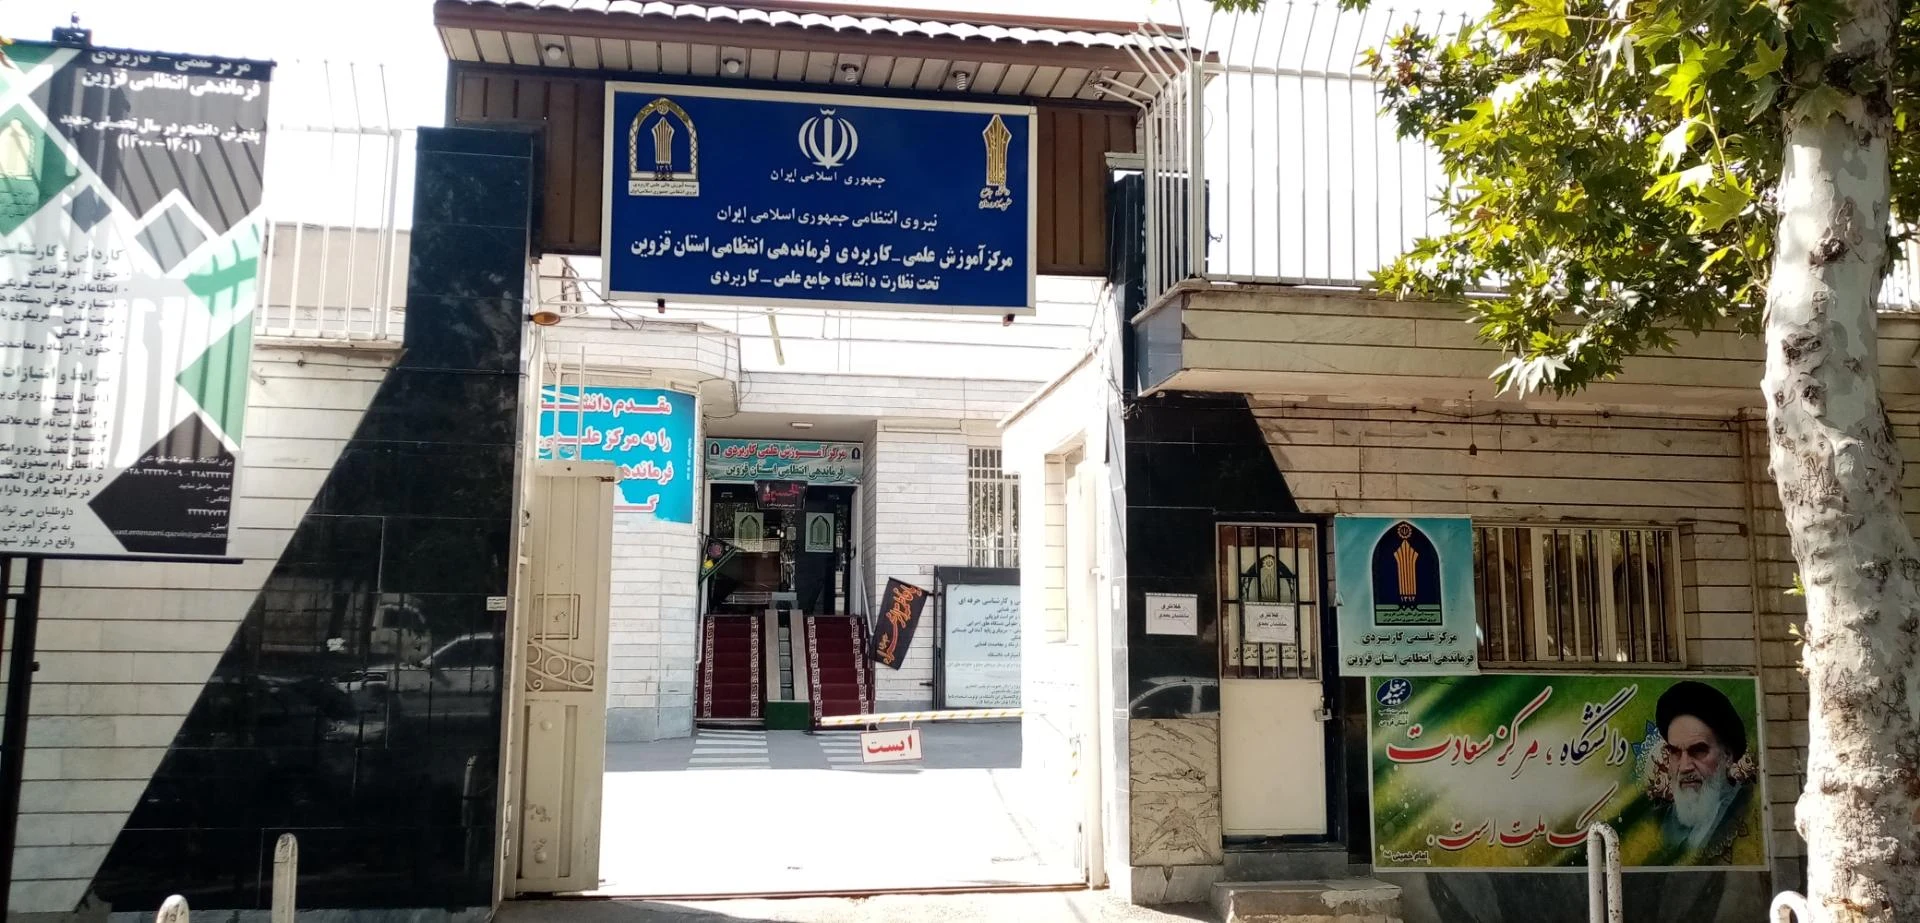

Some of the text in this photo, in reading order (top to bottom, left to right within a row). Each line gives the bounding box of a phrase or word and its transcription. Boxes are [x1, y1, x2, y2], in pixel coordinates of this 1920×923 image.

[81, 68, 261, 101] فرماندهی انتظامی قزوین
[60, 114, 260, 145] پذیرش دانشجو در سال تحصیلی جدید
[770, 168, 887, 188] جمهوری اسلامی ایران
[716, 204, 938, 229] نیروی انتظامی جمهوری اسلامی ایران
[73, 247, 126, 265] کاردانی
[630, 229, 1013, 272] مرکز آموزش علمی کاربردی فرماندهی انتظامی استان قزوین
[34, 280, 68, 293] حراست
[78, 283, 117, 293] انتظامات
[709, 268, 940, 291] تحت نظارت دانشگاه جامع علمی کاربردی
[2, 365, 56, 383] امتیازات
[57, 372, 66, 385] و
[613, 395, 672, 418] مقدم
[602, 427, 641, 452] مرکز
[641, 430, 657, 451] به
[658, 428, 671, 453] را
[724, 442, 848, 461] مرکز آموزش علمی کاربردی
[726, 461, 845, 480] فرماندهی انتظامی استان قزوین
[1362, 631, 1457, 645] مرکز علمی کاربردی
[1347, 651, 1474, 667] فرماندهی انتظامی استان قزوین
[1386, 683, 1639, 782] دانشگاه مرکز سعادت
[867, 734, 912, 757] ایست
[1436, 816, 1496, 850] است
[1498, 813, 1546, 846] ملت
